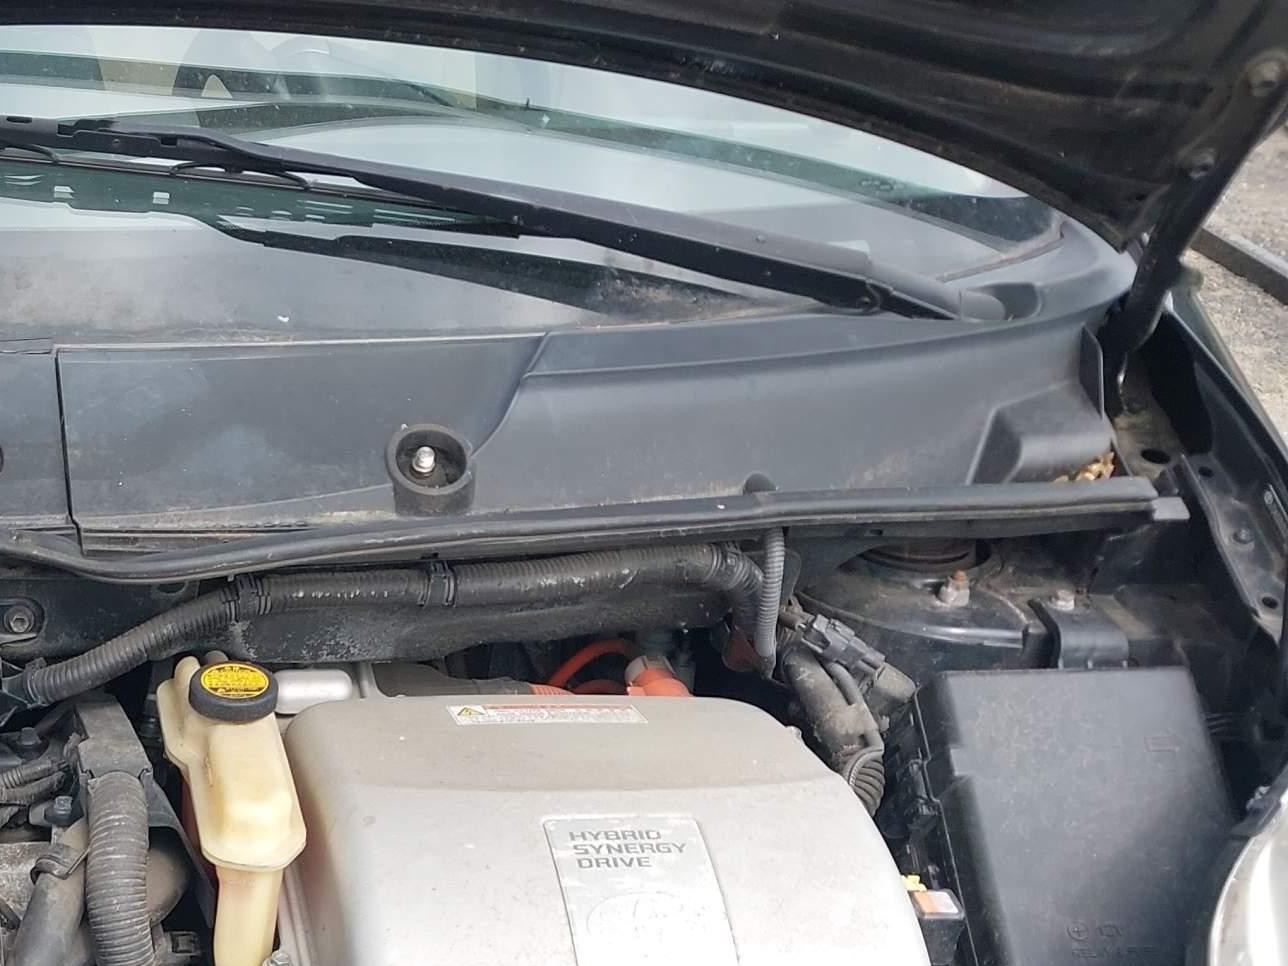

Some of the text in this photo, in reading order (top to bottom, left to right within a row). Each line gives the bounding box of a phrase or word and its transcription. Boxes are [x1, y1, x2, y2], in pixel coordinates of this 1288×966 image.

[568, 829, 662, 841] HYBRID
[573, 842, 687, 855] SYNERGY
[576, 856, 653, 869] DRIVE
